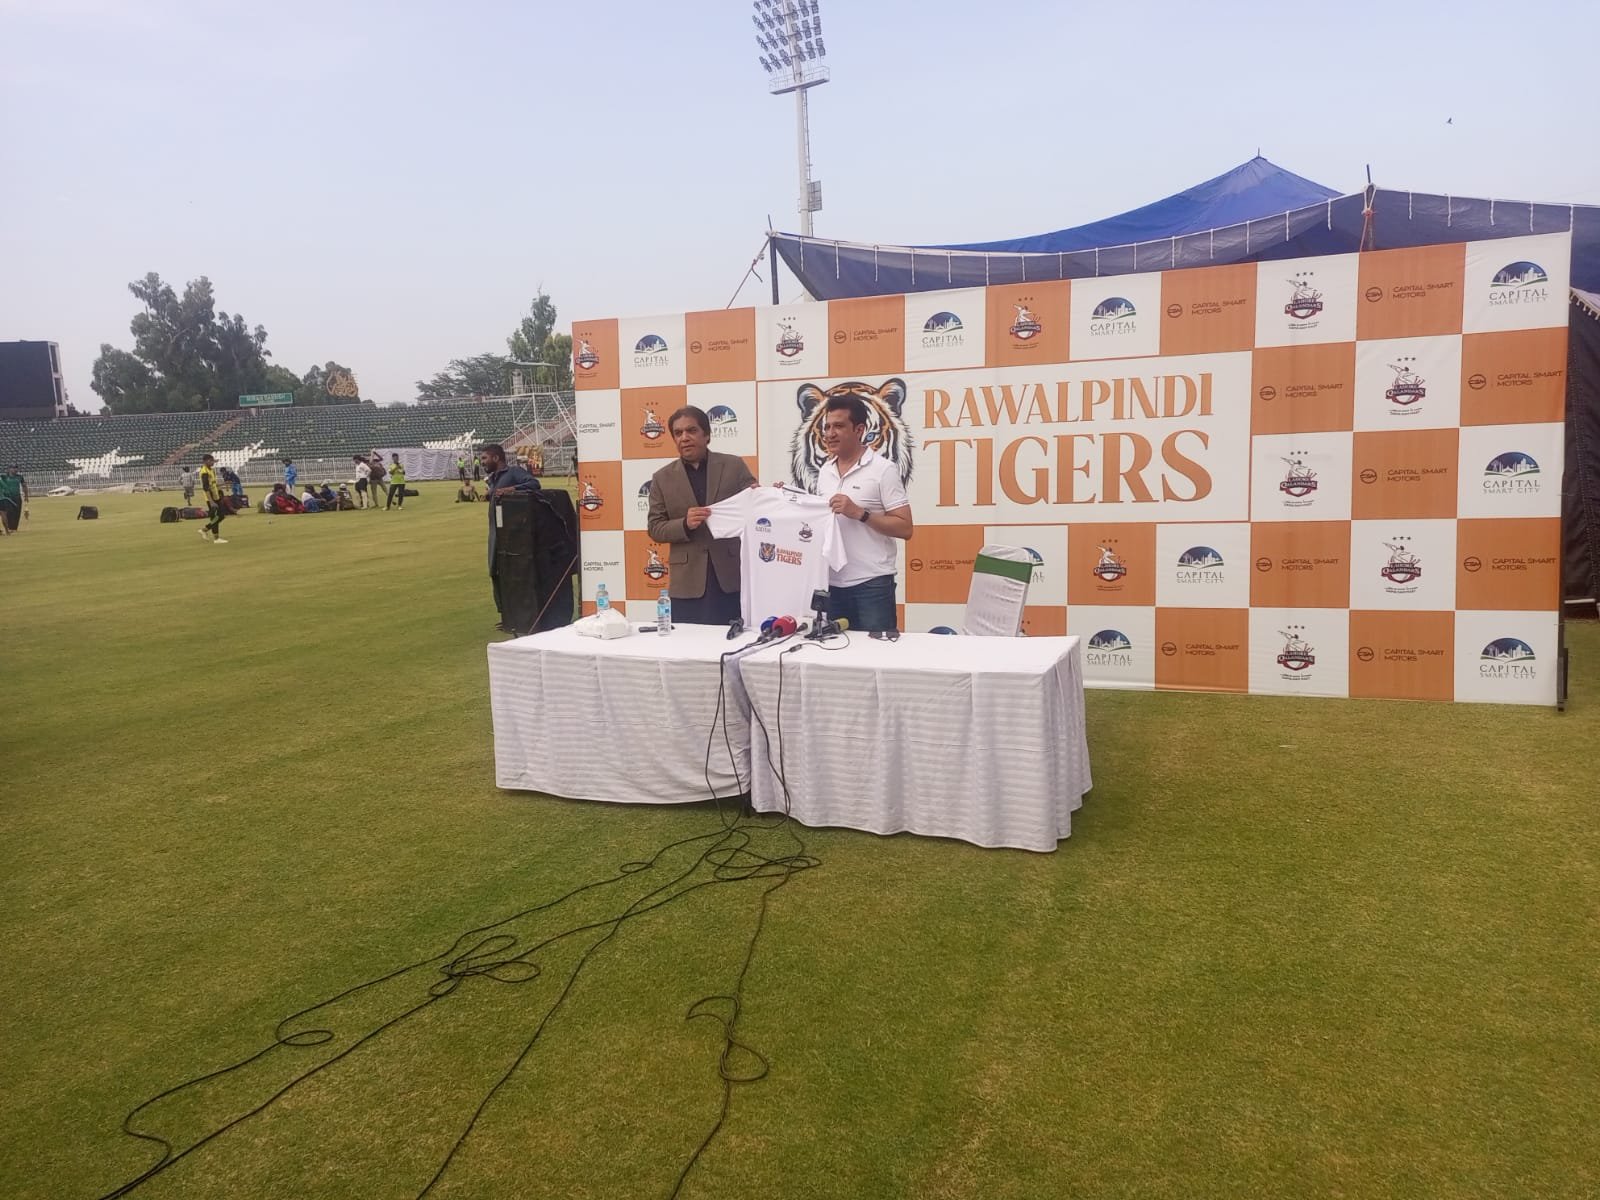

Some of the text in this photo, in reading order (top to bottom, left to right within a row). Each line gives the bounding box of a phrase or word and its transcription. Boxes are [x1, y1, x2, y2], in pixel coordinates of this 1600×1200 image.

[1426, 282, 1454, 290] SMART
[1392, 291, 1426, 299] MOTORS
[1489, 288, 1548, 300] CAPITAL
[1192, 307, 1221, 315] MOTORS
[1090, 321, 1136, 331] CAPITAL
[922, 335, 964, 344] CAPITAL
[634, 355, 669, 364] CAPITAL
[1497, 370, 1563, 380] CAPITAL SMART
[1497, 379, 1533, 387] MOTORS
[922, 373, 1213, 428] RAWALPINDI
[923, 429, 1212, 507] TIGERS
[1483, 480, 1540, 488] CAPITAL
[1087, 653, 1132, 662] CAPITAL
[1479, 664, 1536, 673] CAPITAL
